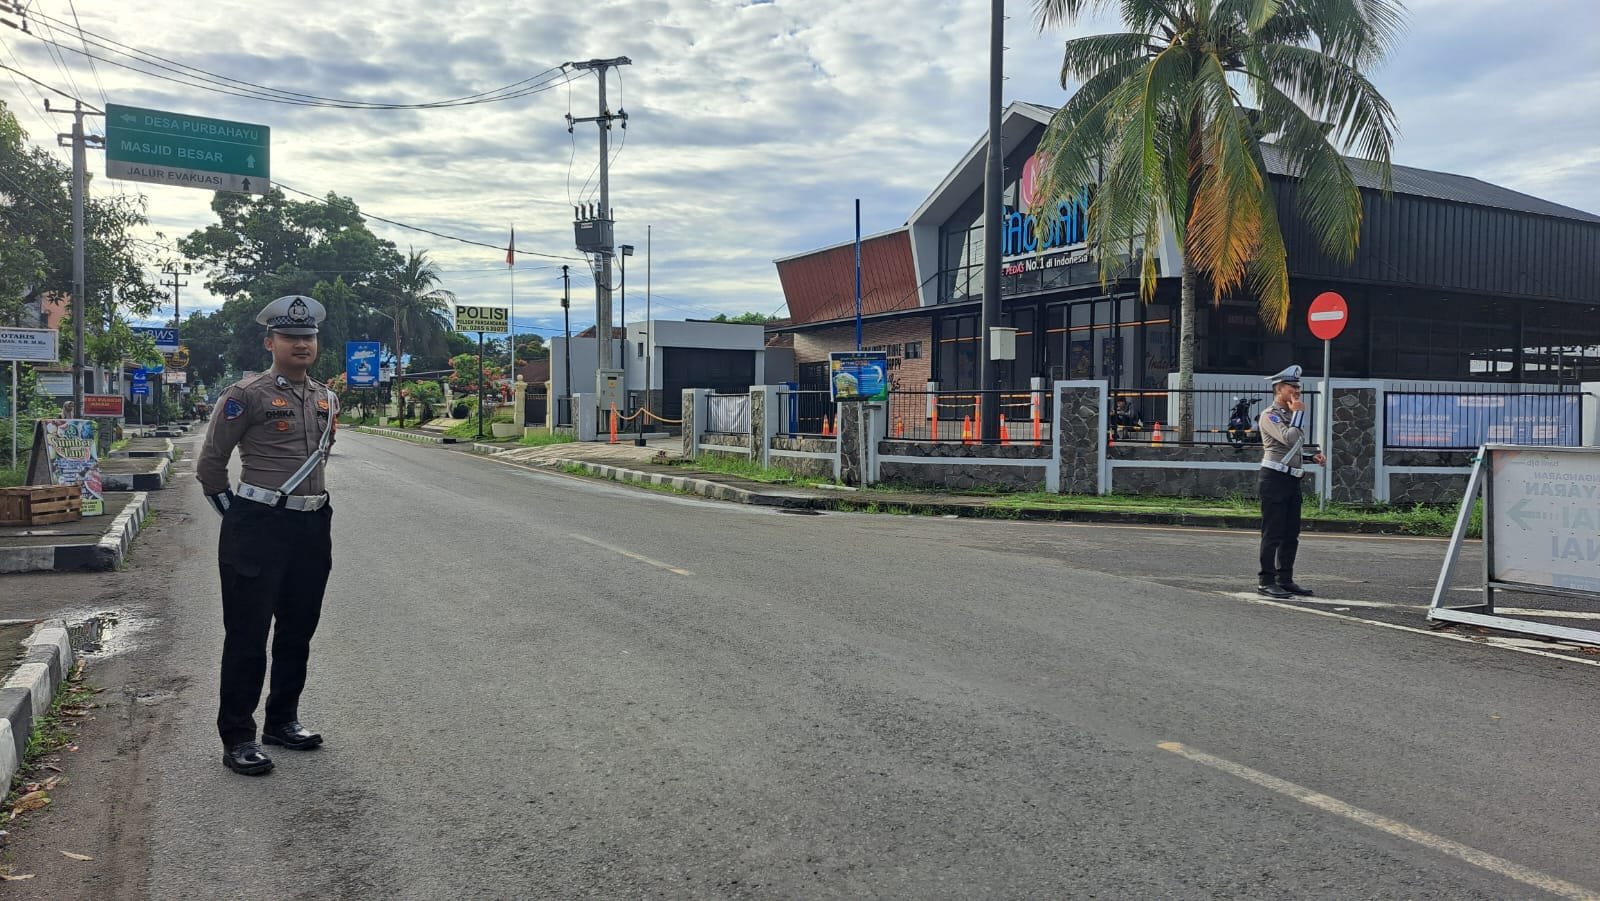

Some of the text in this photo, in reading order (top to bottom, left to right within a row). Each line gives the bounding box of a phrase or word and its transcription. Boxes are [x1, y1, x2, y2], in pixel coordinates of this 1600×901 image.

[144, 115, 259, 140] DESA PURBAHAYU
[120, 140, 224, 163] MASJID BESAR
[127, 167, 223, 185] JALUR EVAKUASI
[1025, 257, 1045, 272] No.1
[1054, 254, 1088, 267] Indonesia
[456, 306, 508, 320] POLISI
